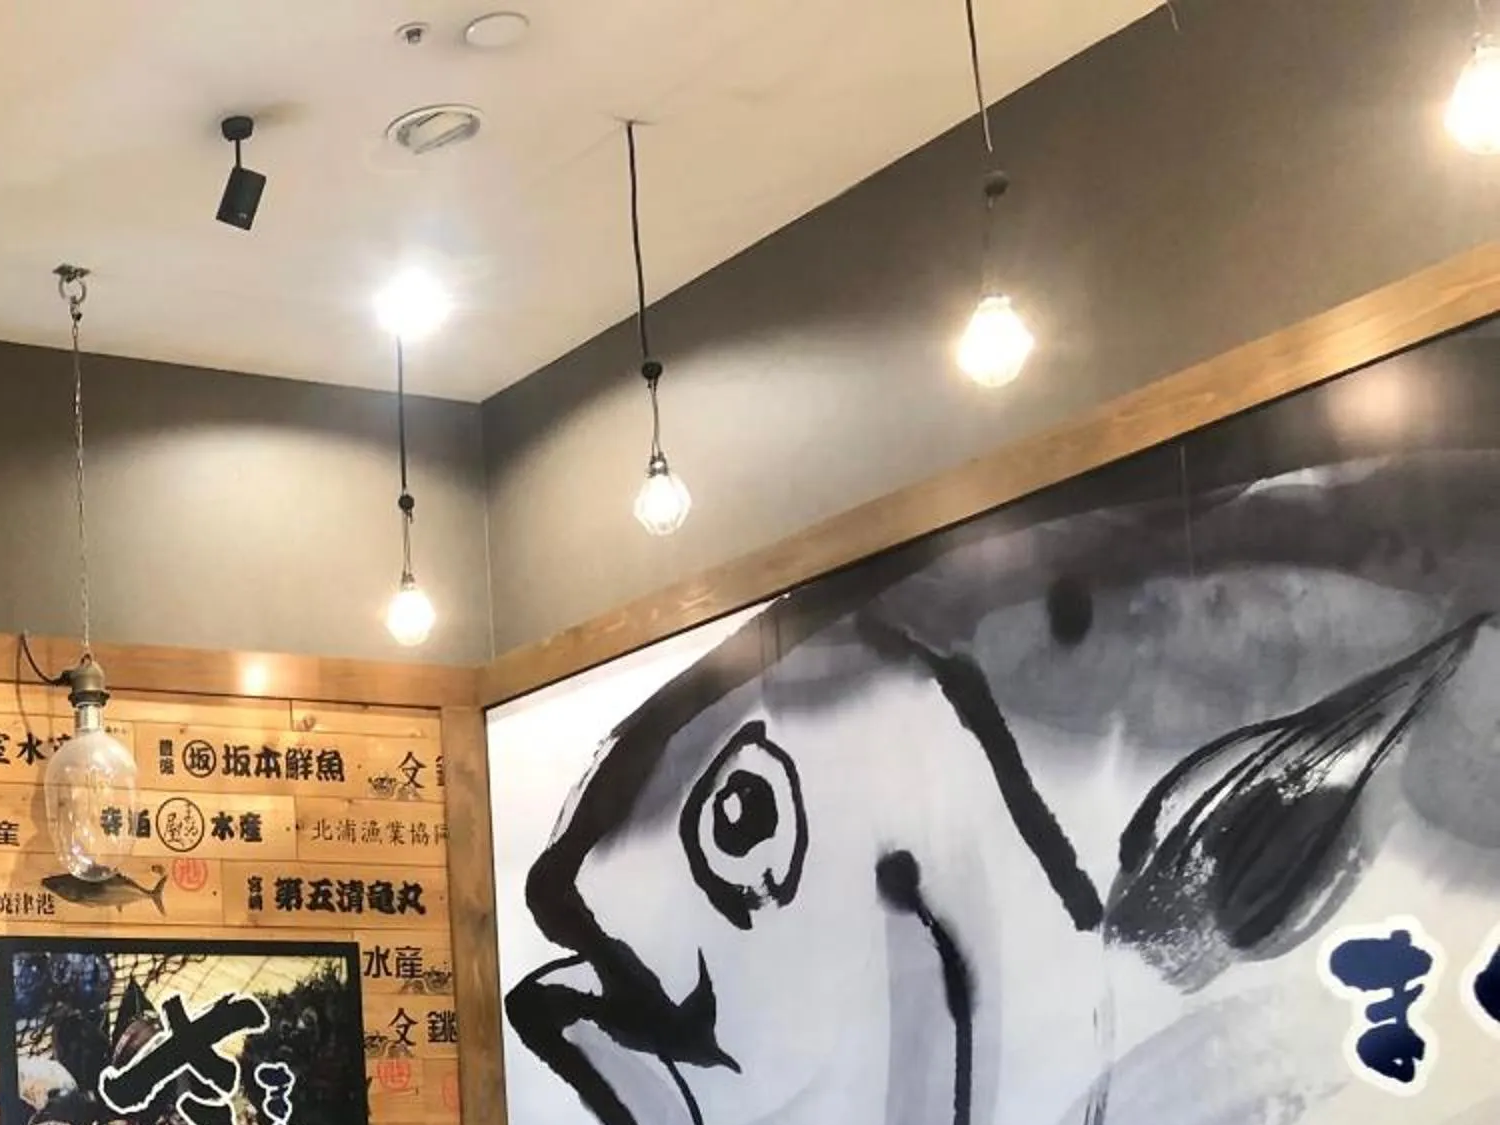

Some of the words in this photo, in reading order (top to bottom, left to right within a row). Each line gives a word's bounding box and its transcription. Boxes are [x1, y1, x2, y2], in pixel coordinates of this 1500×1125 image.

[222, 744, 346, 782] 坂本鮮魚
[362, 945, 423, 979] 水産
